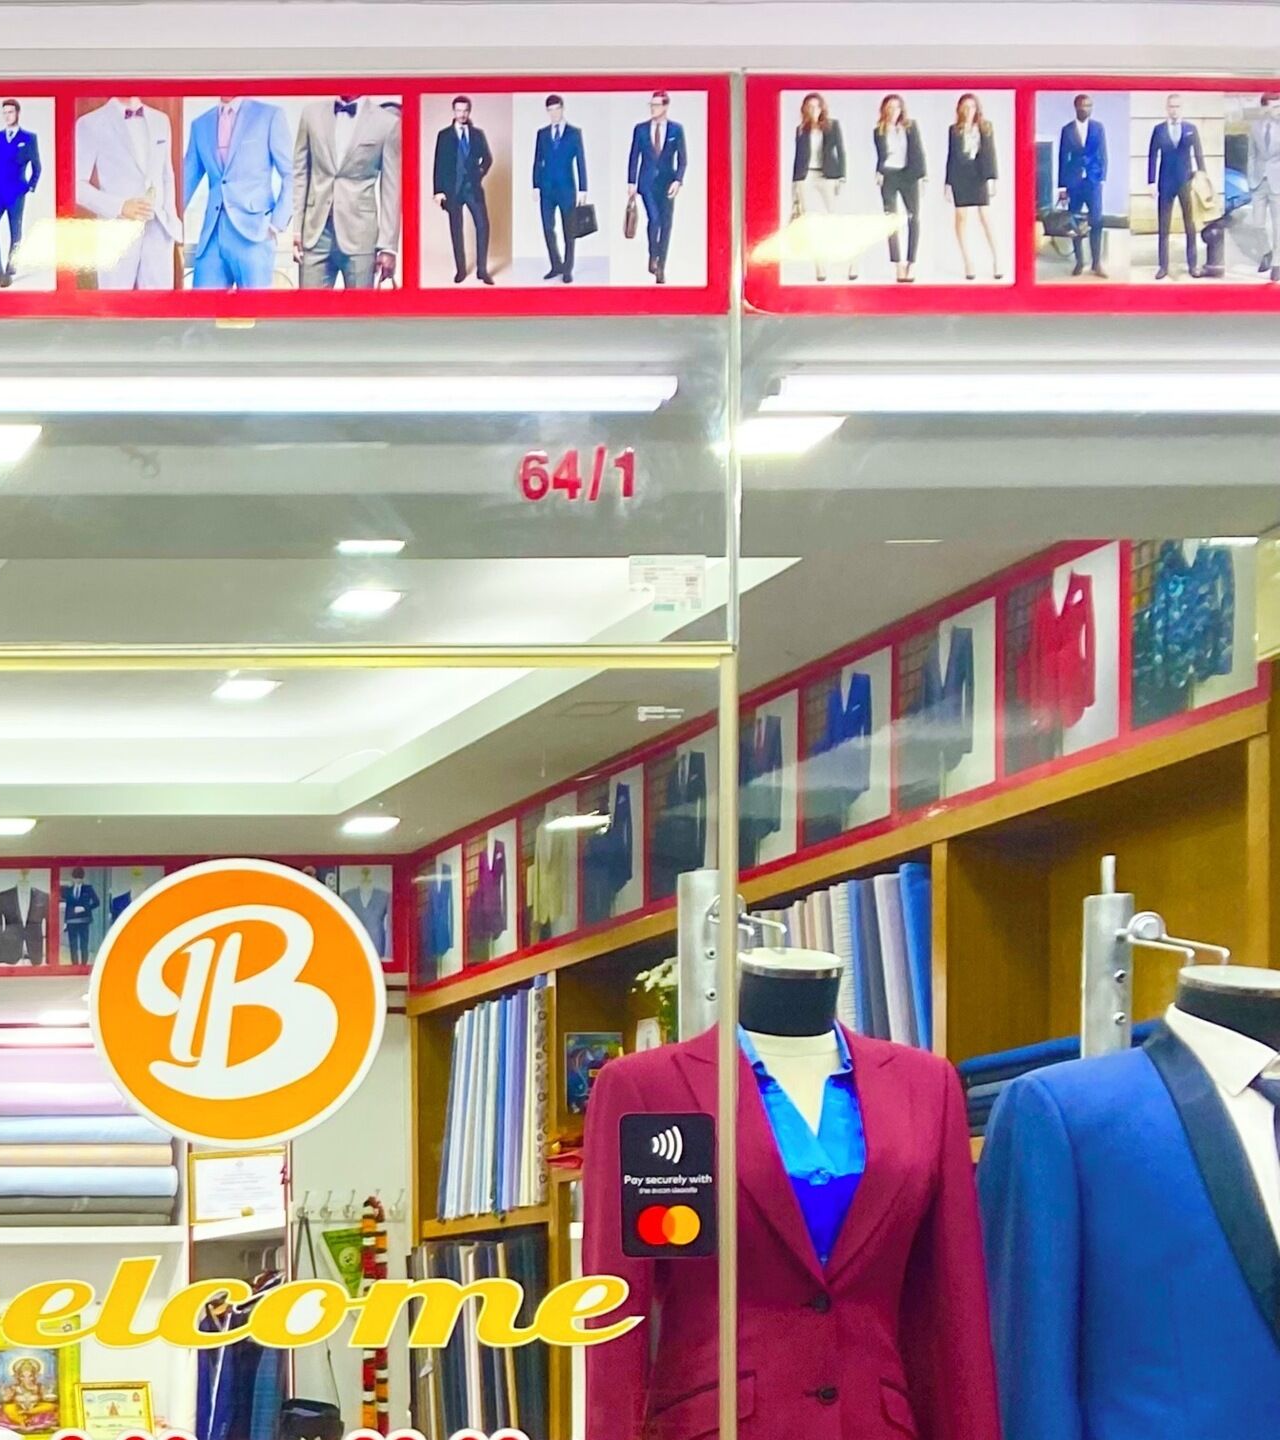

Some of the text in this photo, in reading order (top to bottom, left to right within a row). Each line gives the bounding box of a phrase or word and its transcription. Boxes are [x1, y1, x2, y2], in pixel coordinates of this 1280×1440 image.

[517, 445, 637, 501] 64/1
[623, 1173, 712, 1186] Pay securely with
